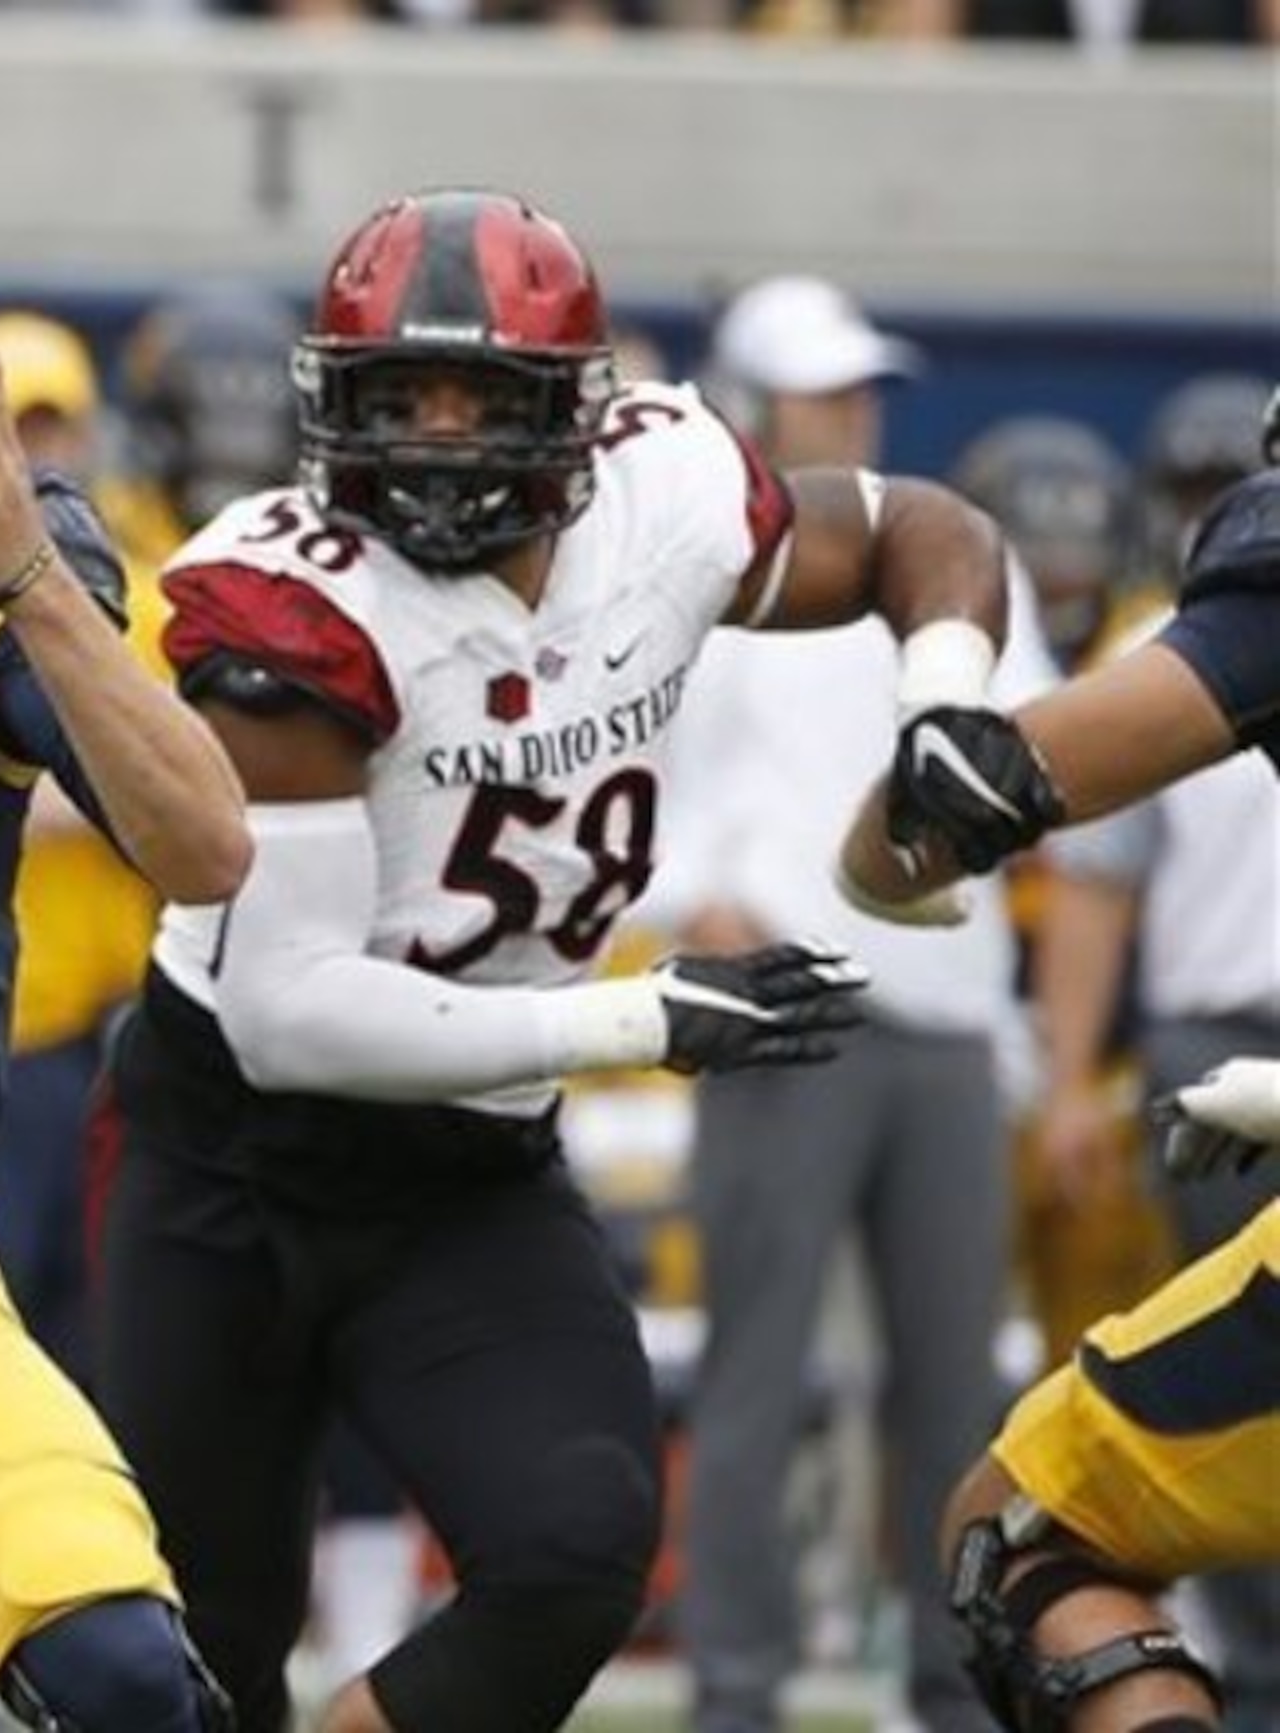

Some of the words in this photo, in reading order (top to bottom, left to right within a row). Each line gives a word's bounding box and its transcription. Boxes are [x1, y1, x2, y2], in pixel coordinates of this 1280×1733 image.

[425, 744, 505, 788] SAN
[519, 716, 599, 781] DIO
[407, 766, 657, 974] 58
